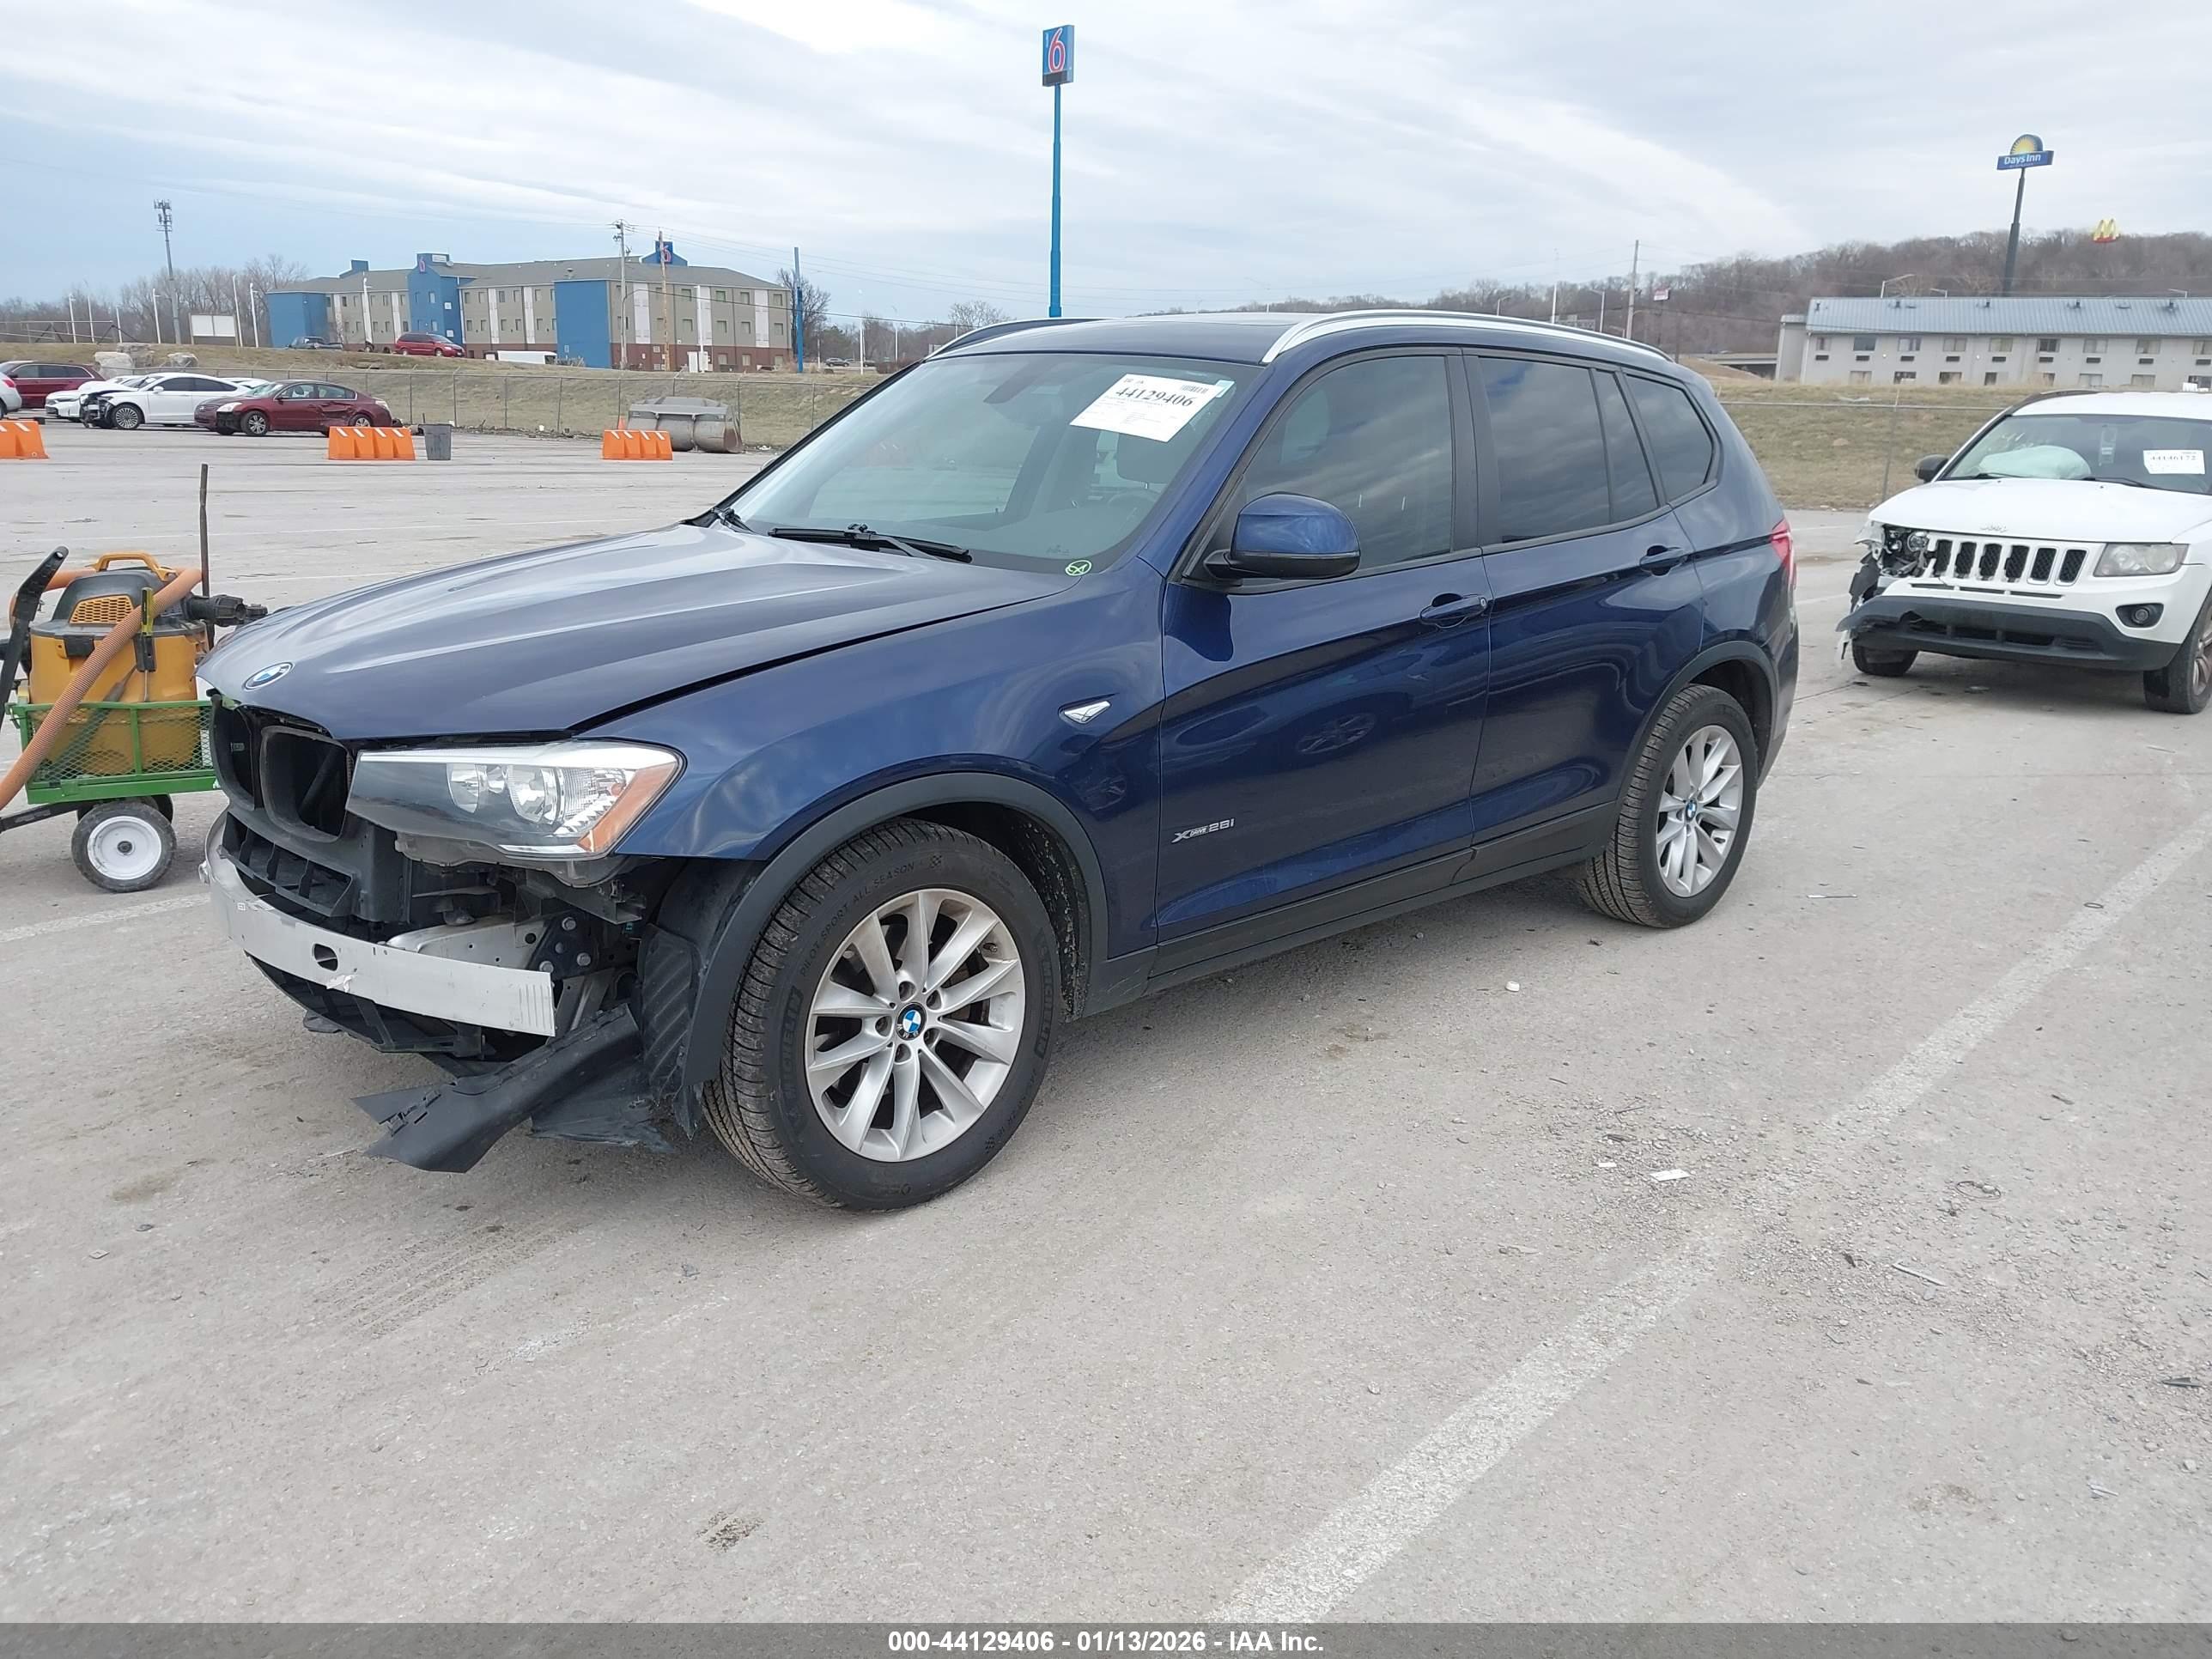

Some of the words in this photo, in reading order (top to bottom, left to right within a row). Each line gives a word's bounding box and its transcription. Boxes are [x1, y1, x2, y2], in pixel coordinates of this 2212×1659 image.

[1048, 27, 1066, 73] 6
[2003, 156, 2025, 166] Days
[1115, 387, 1198, 407] 44129406
[801, 943, 820, 977] PILOT
[820, 904, 849, 939] SPORT
[853, 885, 872, 904] ALL
[873, 861, 915, 888] SEASON
